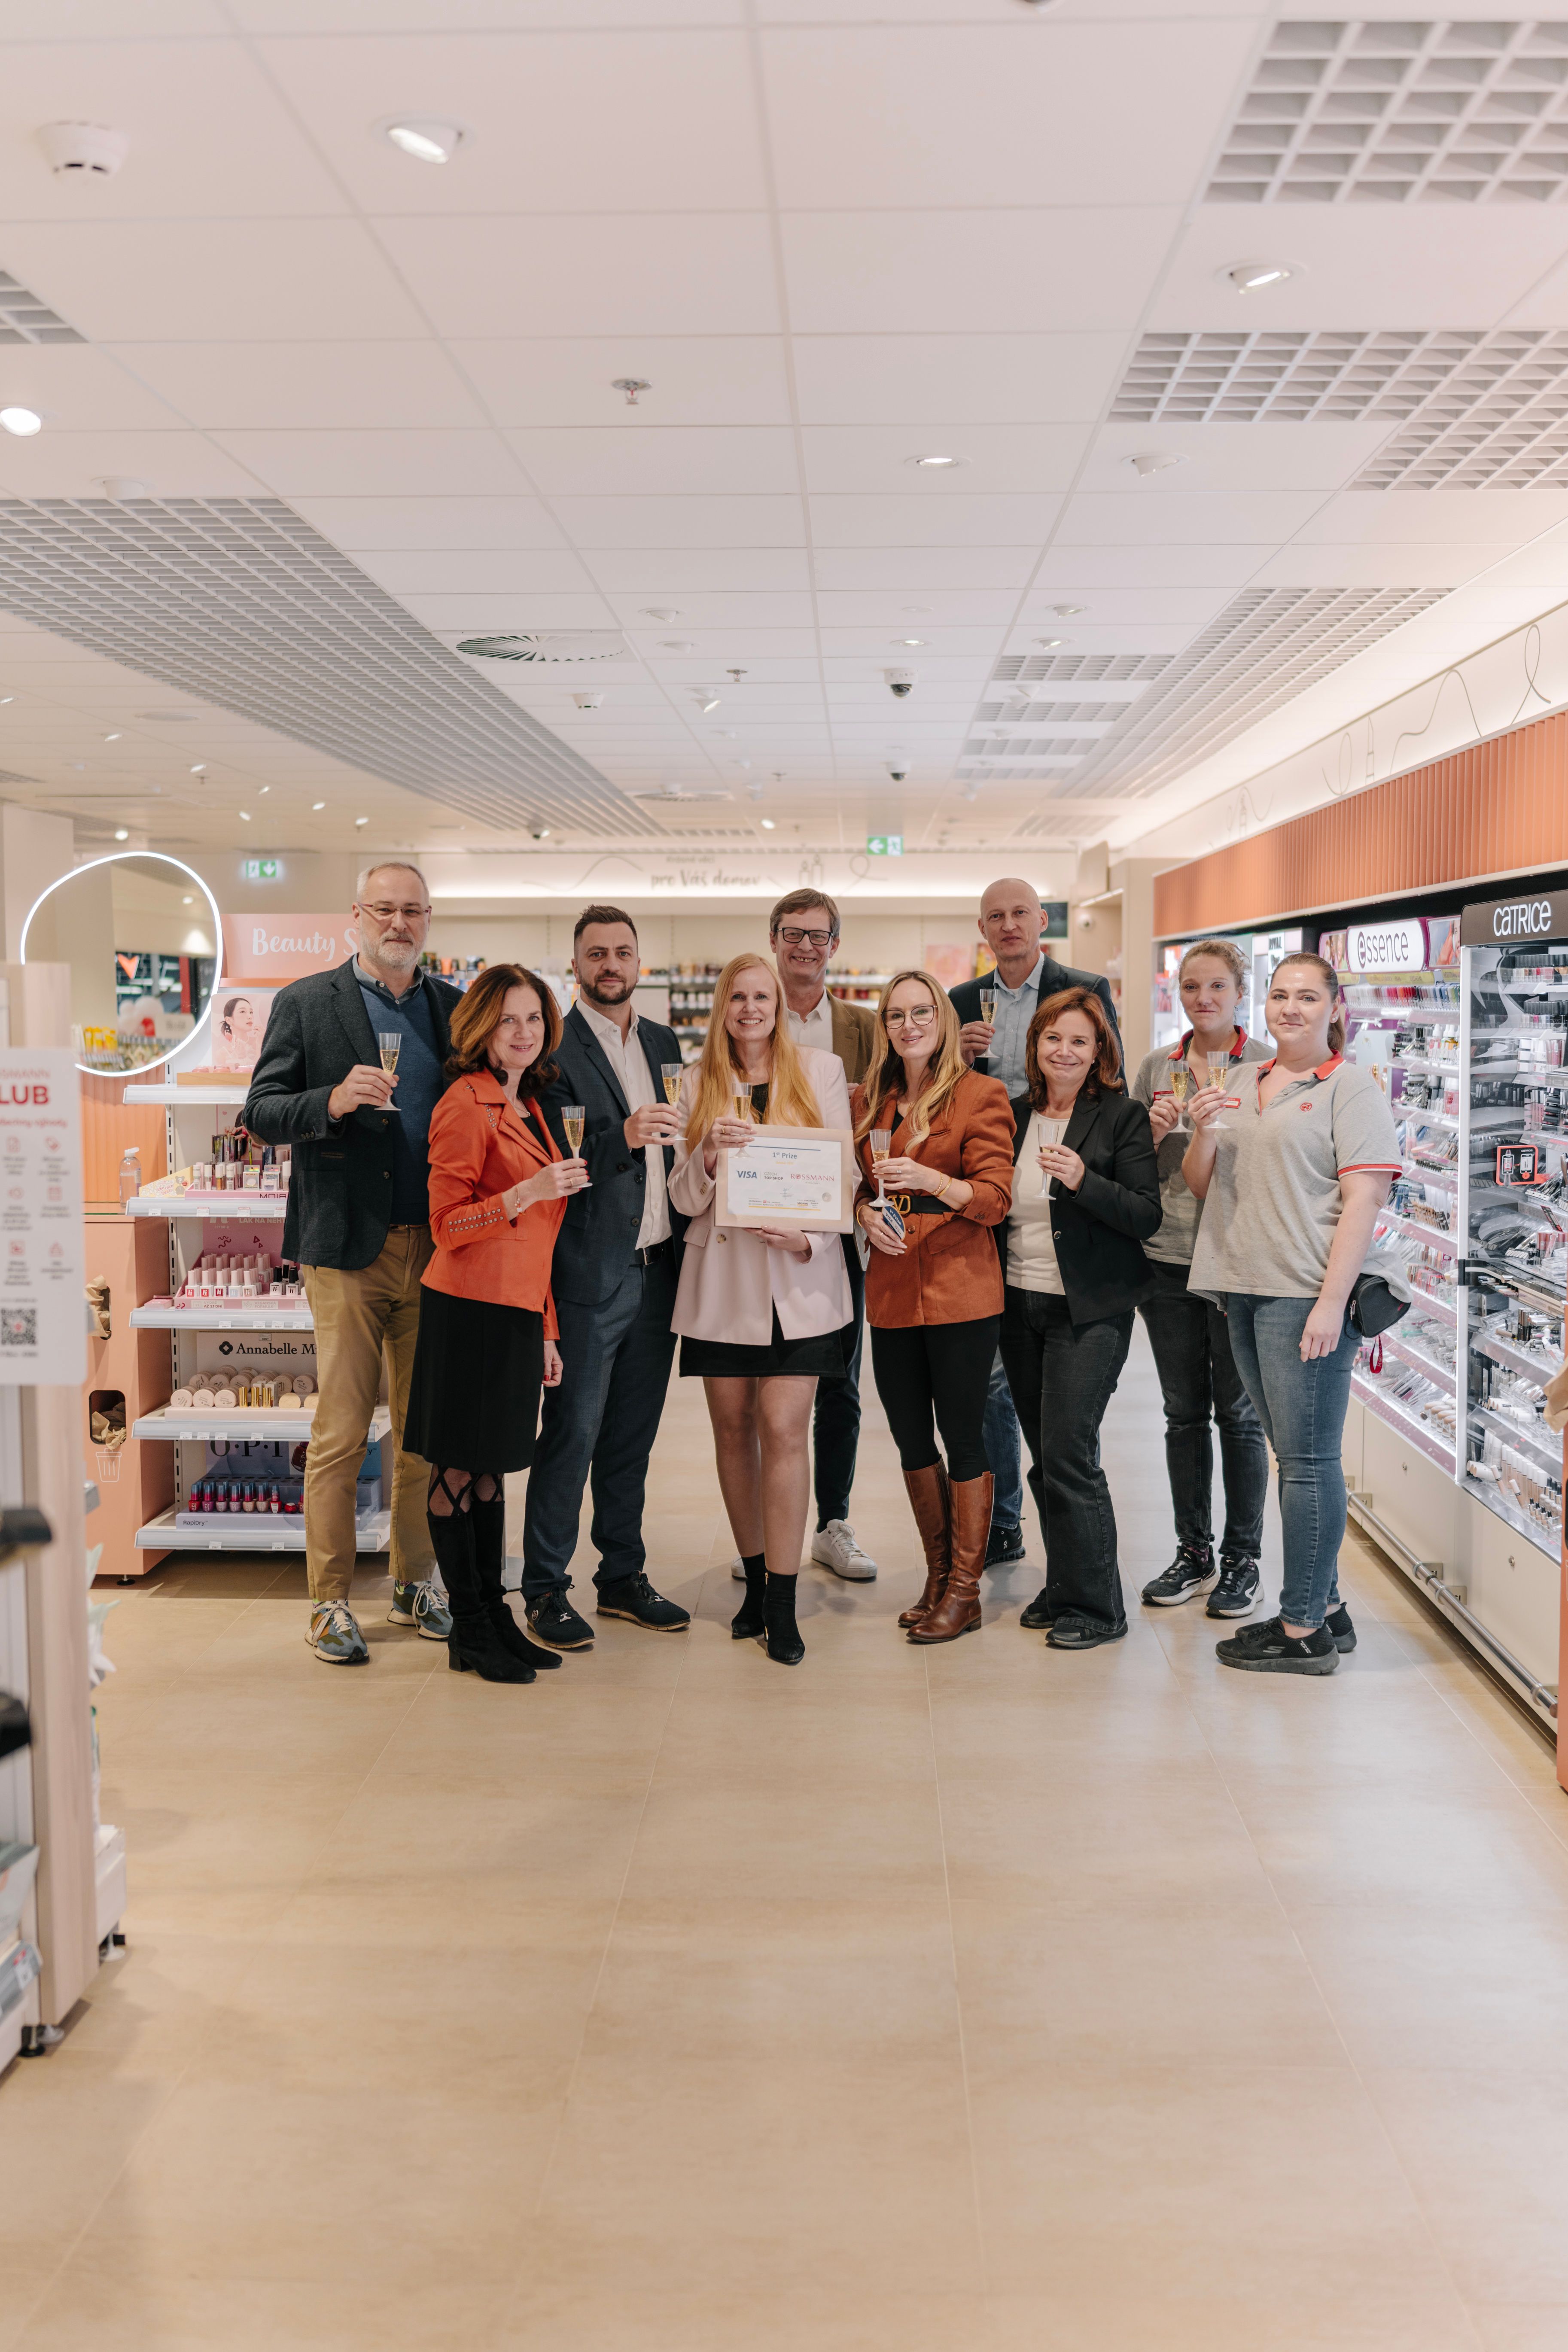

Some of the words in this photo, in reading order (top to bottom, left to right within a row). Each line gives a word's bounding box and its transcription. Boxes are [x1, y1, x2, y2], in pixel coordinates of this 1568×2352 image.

[651, 875, 675, 891] pro
[680, 869, 708, 887] Váš
[713, 868, 761, 886] domov
[253, 928, 335, 962] Beauty
[1357, 931, 1409, 969] essence
[736, 1170, 757, 1178] VISA
[791, 1173, 834, 1181] ROSSMANN
[885, 1212, 893, 1223] VISA
[893, 1213, 901, 1226] Prize
[236, 1343, 298, 1354] Annabelle
[301, 1344, 317, 1354] M
